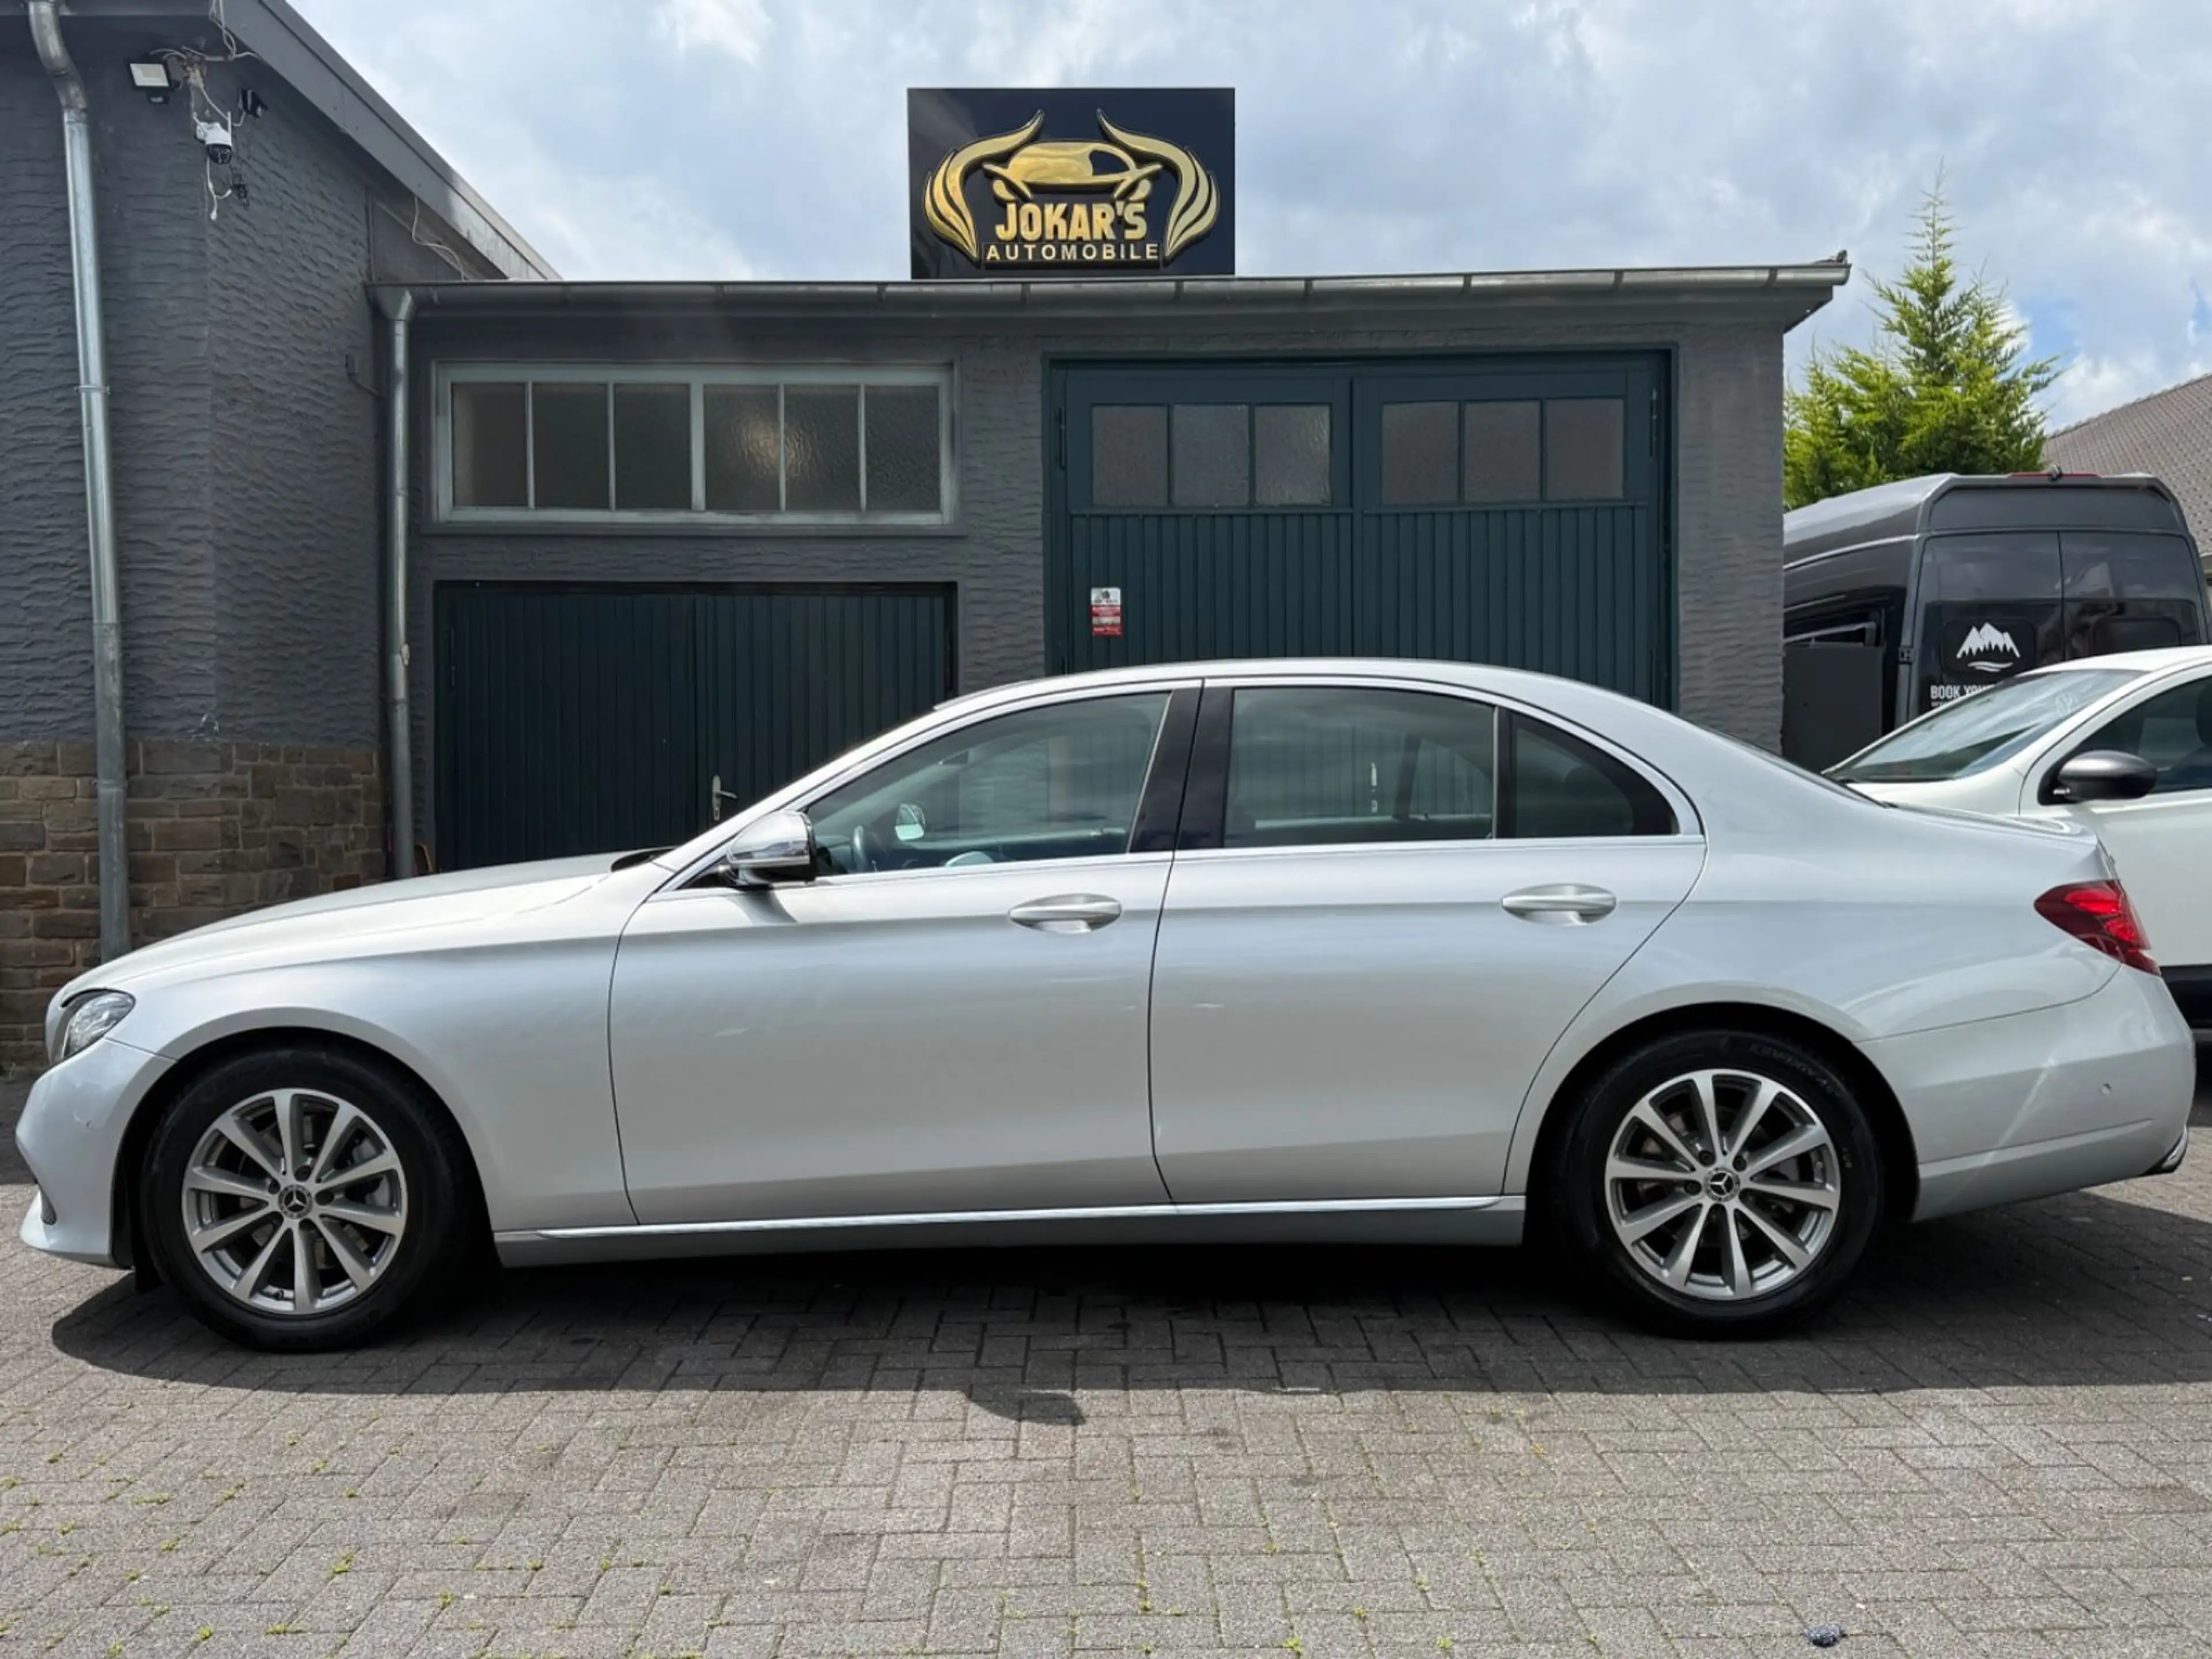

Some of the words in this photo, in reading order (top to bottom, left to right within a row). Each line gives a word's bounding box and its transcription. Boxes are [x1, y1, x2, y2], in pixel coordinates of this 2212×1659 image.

[995, 201, 1147, 241] JOKAR'S
[986, 243, 1158, 260] AUTOMOBILE
[1930, 684, 1960, 699] BOOK
